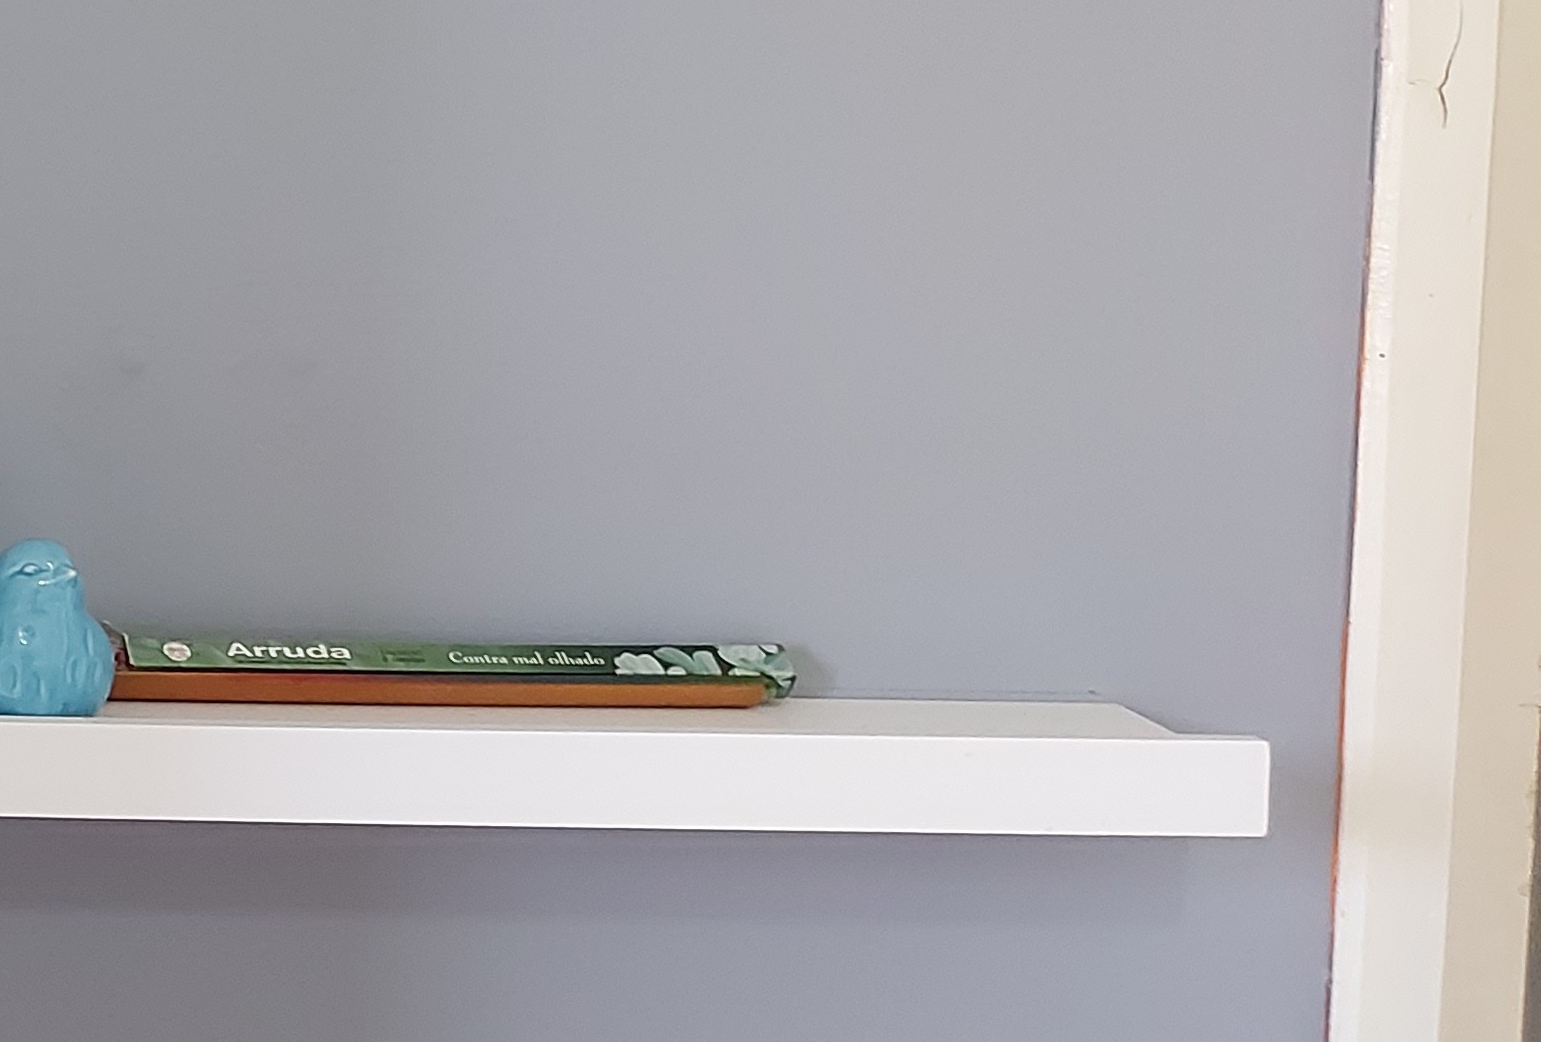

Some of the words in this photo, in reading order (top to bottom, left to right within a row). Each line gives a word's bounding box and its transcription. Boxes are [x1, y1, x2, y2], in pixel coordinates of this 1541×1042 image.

[227, 642, 352, 659] Arruda
[448, 651, 509, 664] Contra
[511, 651, 545, 665] mal
[547, 651, 606, 666] olhado
